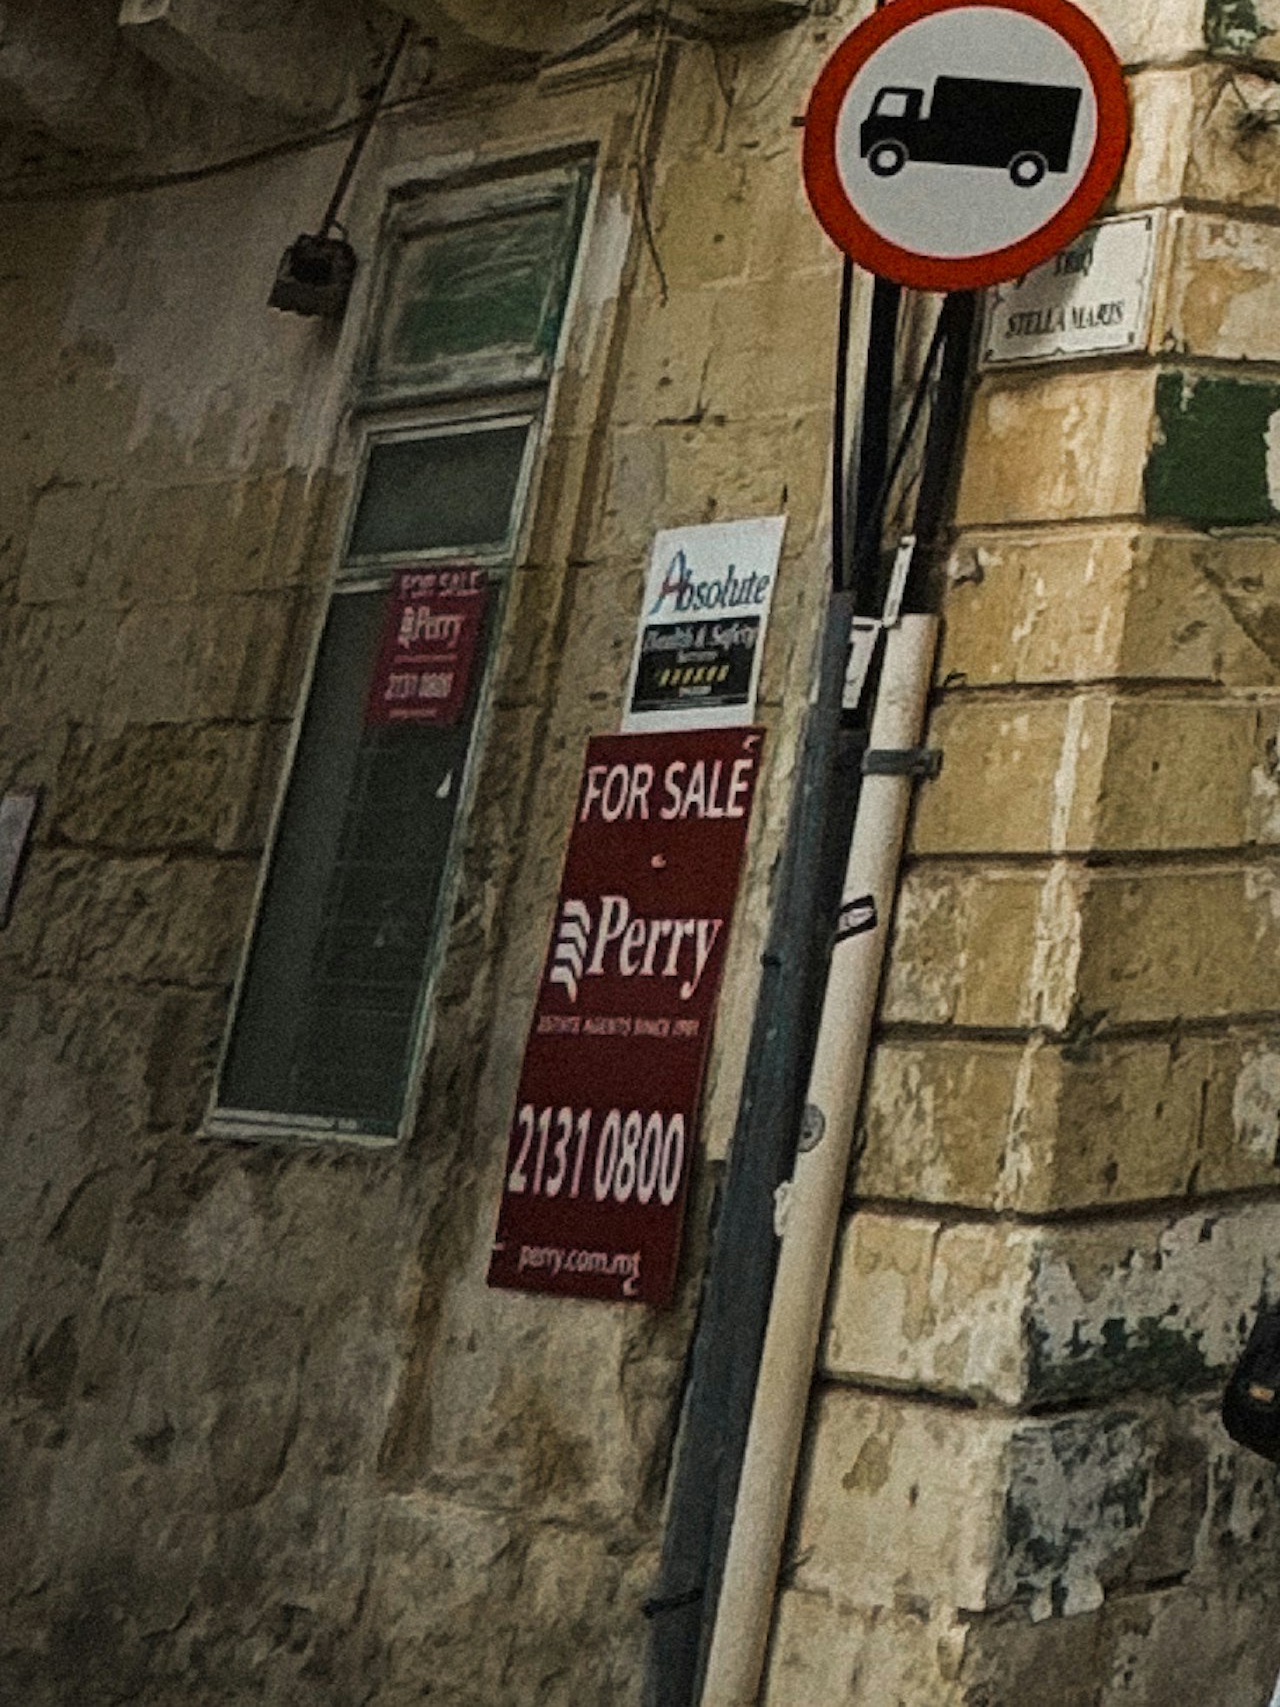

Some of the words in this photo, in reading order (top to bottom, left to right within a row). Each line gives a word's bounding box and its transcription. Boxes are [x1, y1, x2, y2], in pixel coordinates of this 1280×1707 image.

[1006, 306, 1065, 338] STELLA
[649, 548, 771, 616] Absolute
[413, 606, 467, 650] Perry
[580, 764, 650, 823] FOR
[660, 757, 755, 821] SALE
[586, 894, 723, 1000] Perry
[508, 1102, 592, 1199] 2131
[594, 1107, 686, 1208] 0800
